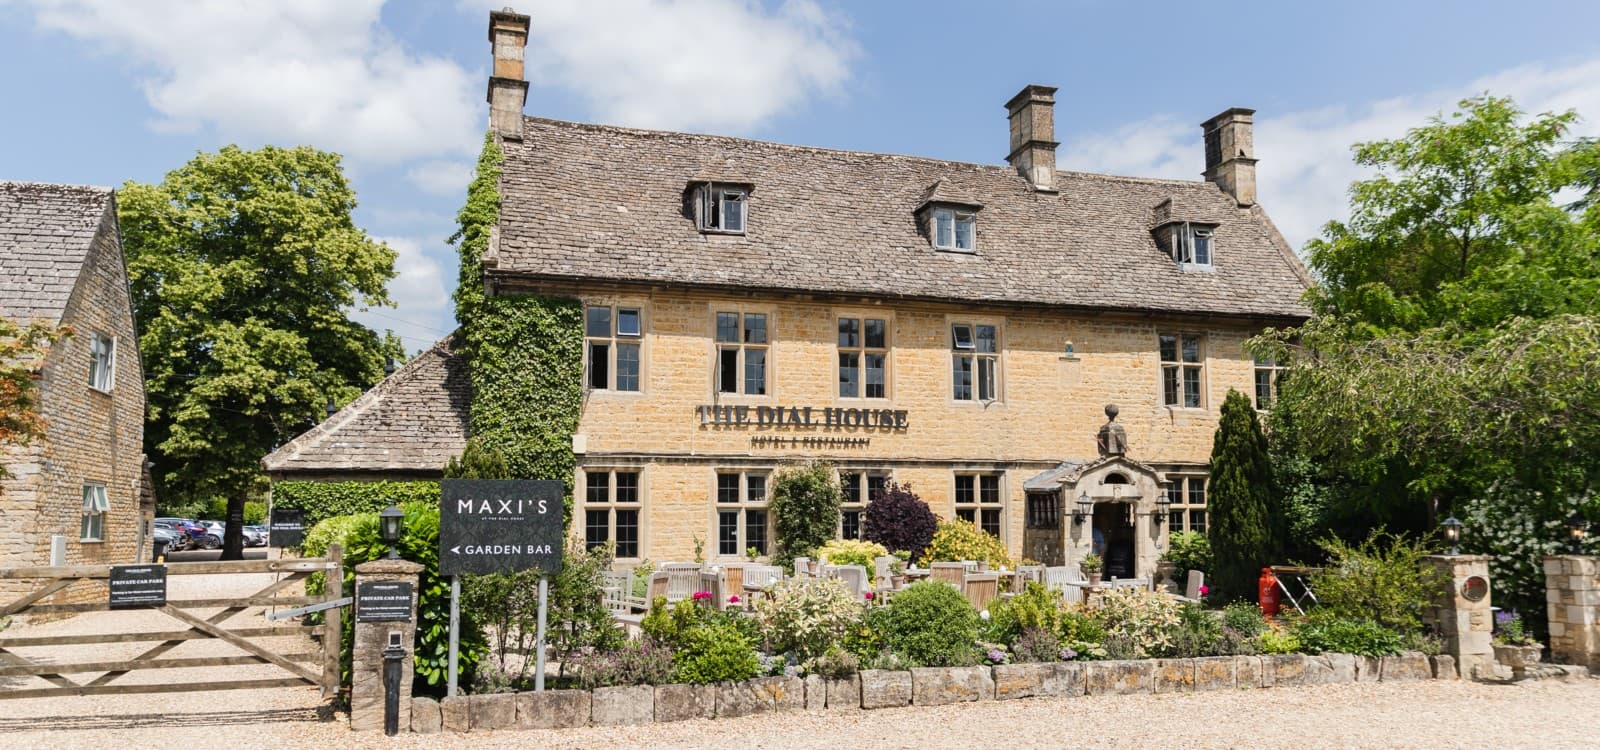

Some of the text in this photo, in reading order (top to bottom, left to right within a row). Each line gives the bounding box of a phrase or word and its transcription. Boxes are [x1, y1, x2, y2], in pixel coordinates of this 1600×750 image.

[696, 405, 909, 429] THE DIAL HOUSE
[751, 436, 786, 446] HOTEL
[803, 436, 870, 447] RESTAURANT
[458, 499, 547, 514] MAXI'S
[465, 545, 552, 554] GARDEN BAR
